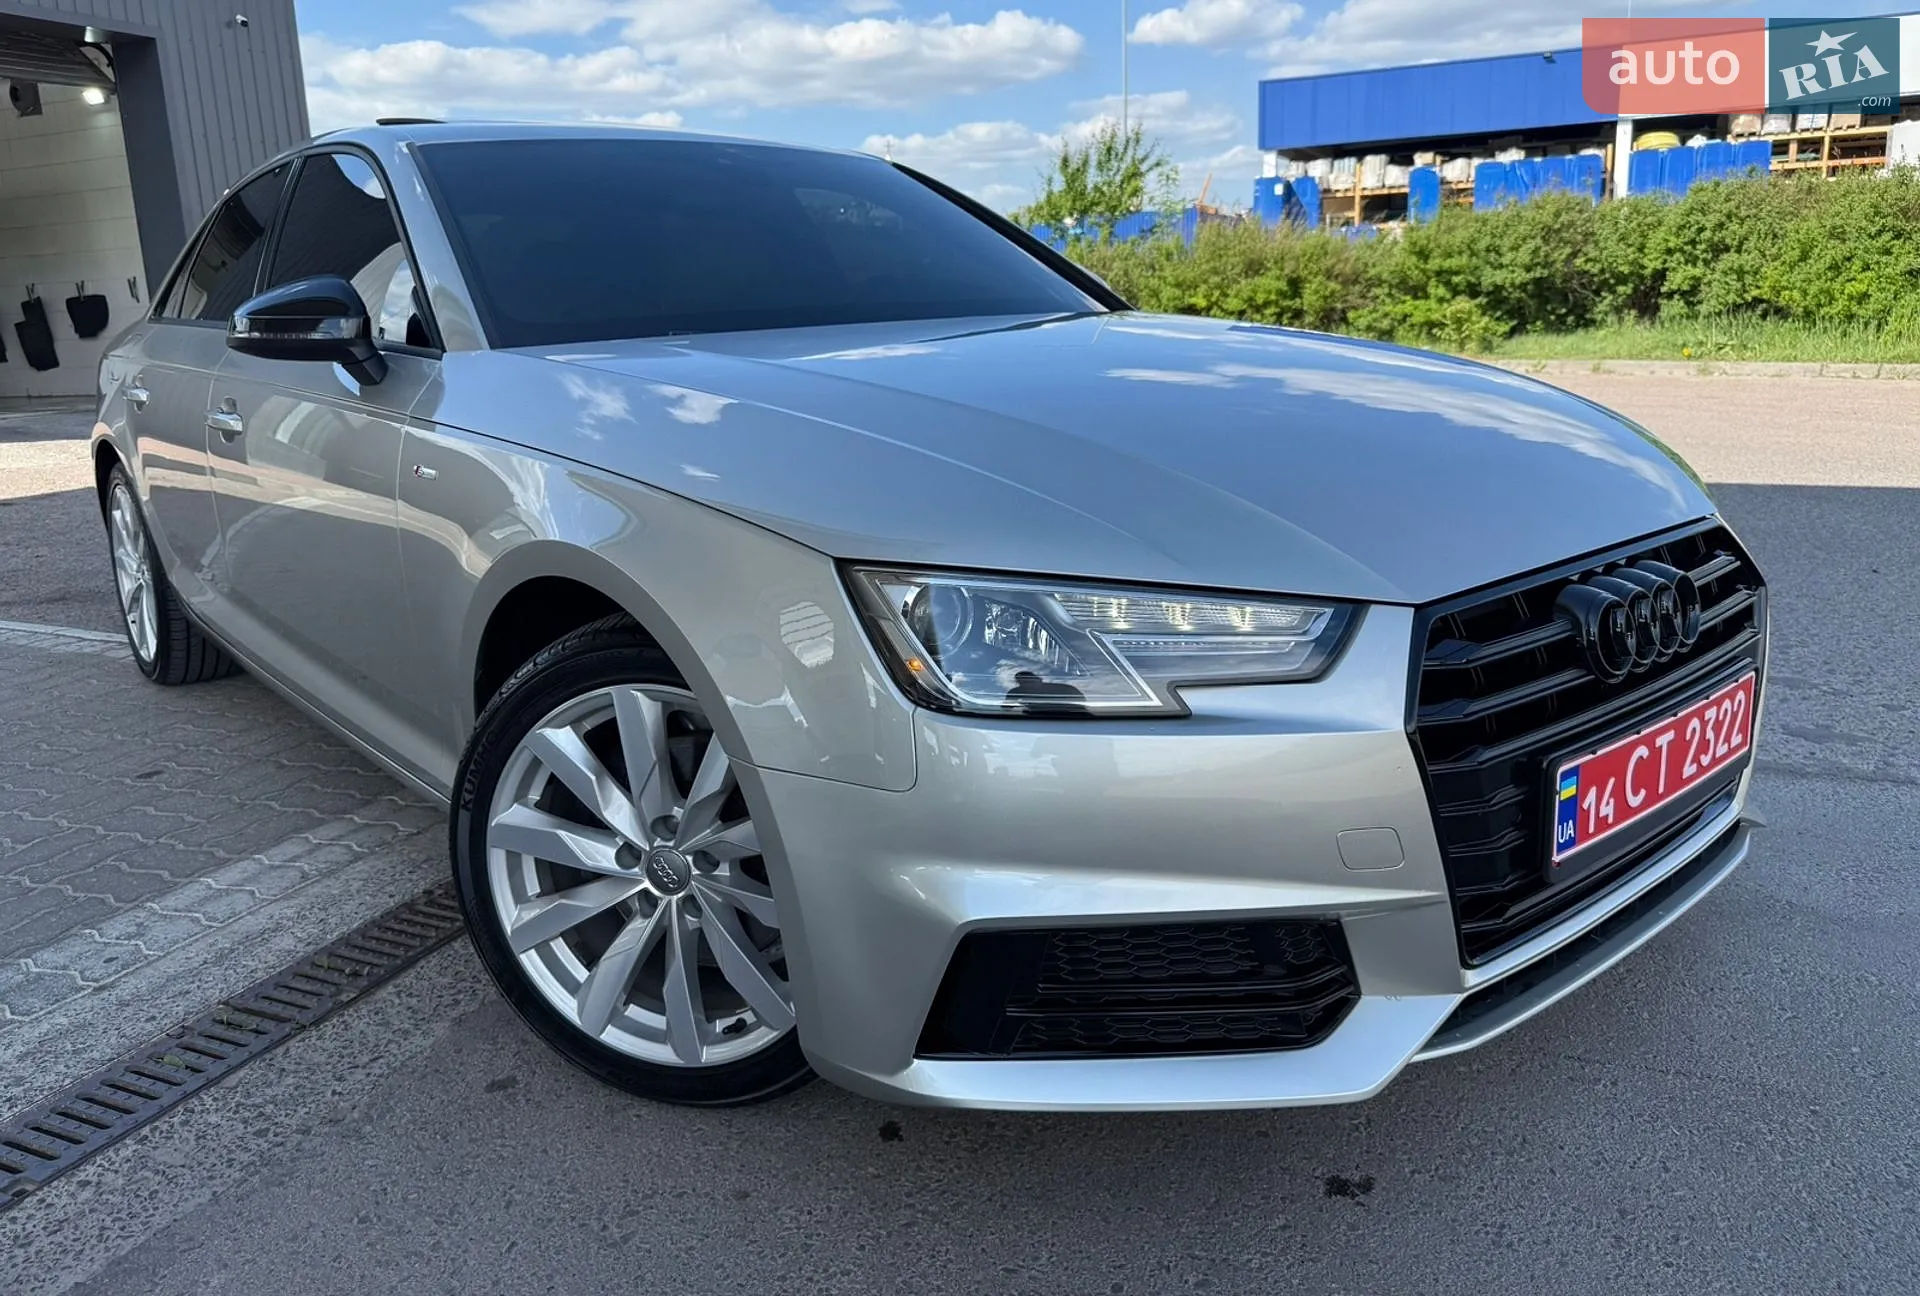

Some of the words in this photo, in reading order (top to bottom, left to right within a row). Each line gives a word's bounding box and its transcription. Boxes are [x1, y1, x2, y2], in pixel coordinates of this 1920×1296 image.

[1582, 776, 1616, 834] 14
[1682, 690, 1746, 780] 2322
[1558, 819, 1575, 843] UA
